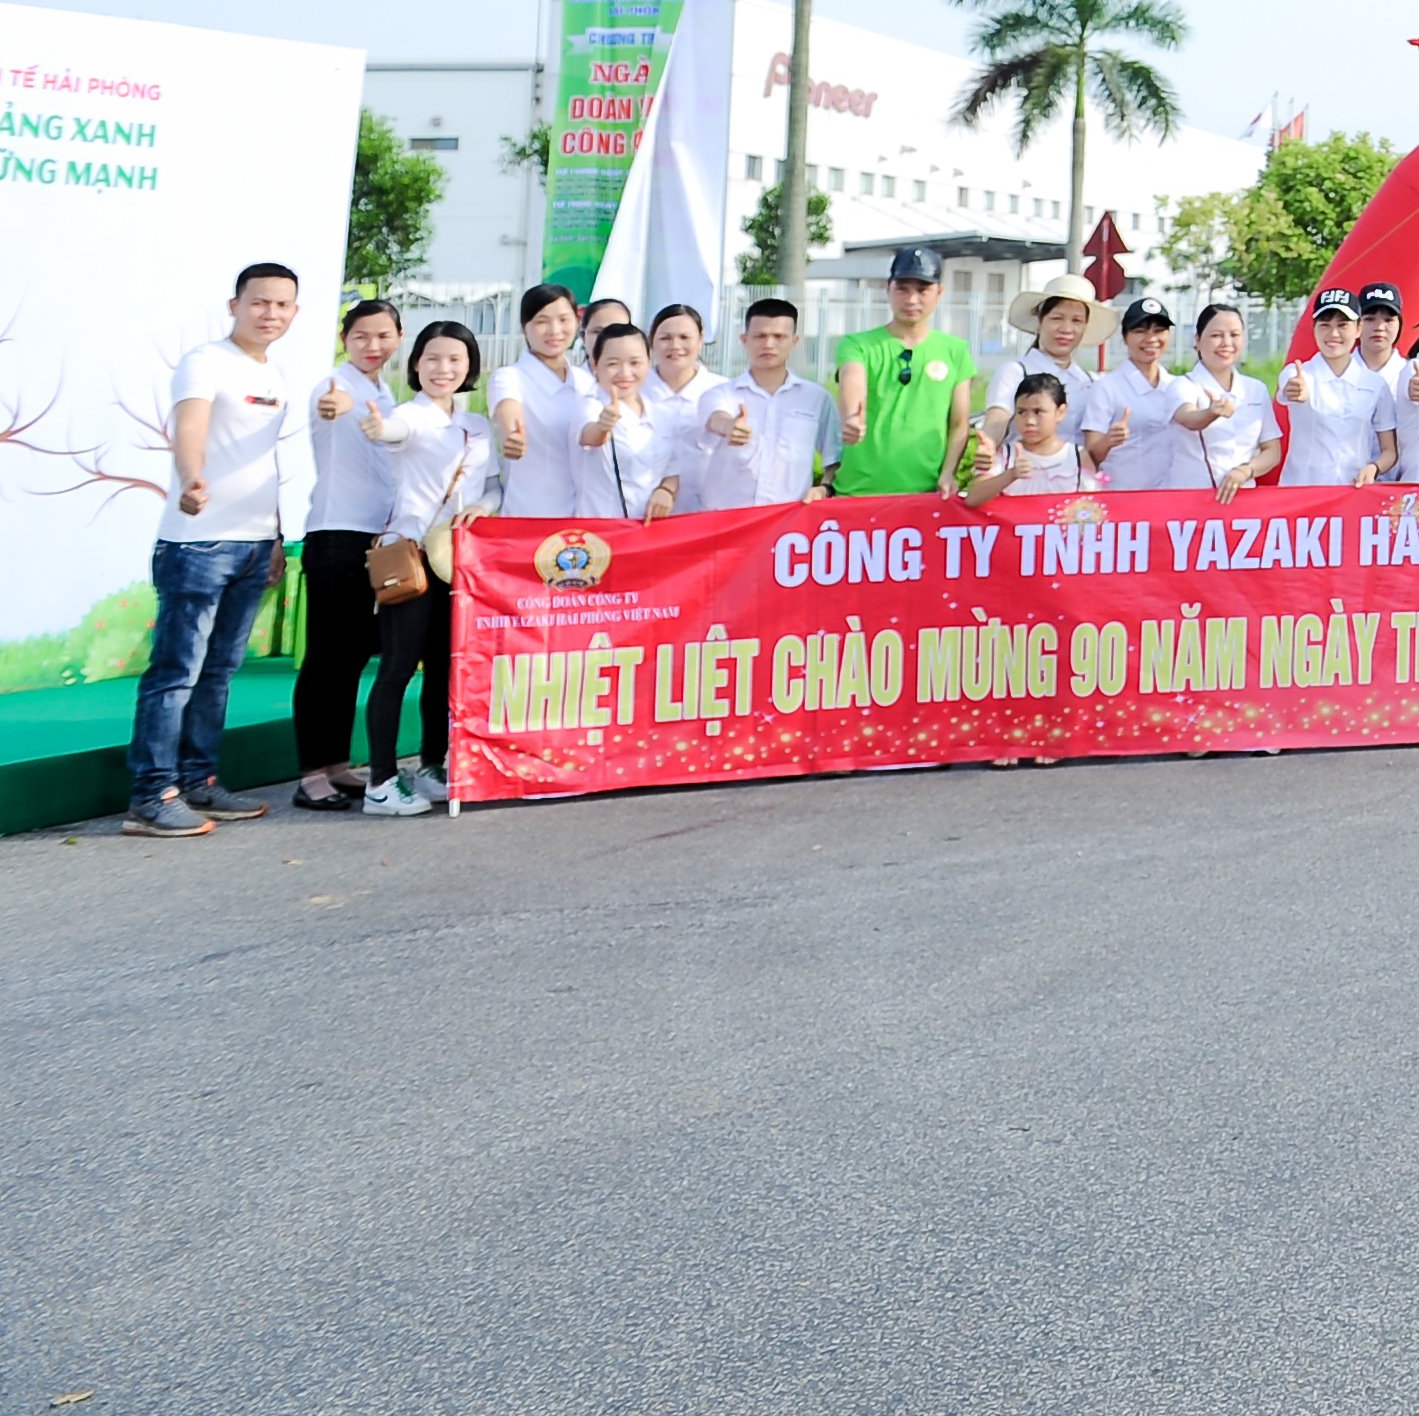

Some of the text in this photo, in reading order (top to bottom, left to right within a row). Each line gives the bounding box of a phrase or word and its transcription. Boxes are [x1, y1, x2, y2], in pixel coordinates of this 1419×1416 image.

[9, 65, 162, 102] TẾ HẢI PHÒNG
[589, 55, 650, 84] NGÀ
[763, 52, 878, 118] pneer
[0, 101, 156, 148] ẢNG XANH
[562, 127, 626, 156] CÔNG
[65, 160, 158, 194] MẠNH
[775, 520, 922, 587] CÔNG
[940, 524, 999, 579] TY
[1015, 521, 1149, 576] TNHH
[1170, 515, 1338, 572] YAZAKI
[488, 632, 645, 745] NHIỆT
[654, 623, 760, 736] LIỆT
[772, 615, 903, 713] CHÀO
[917, 606, 1058, 704] MỪNG
[1070, 621, 1127, 697] 90
[1139, 603, 1247, 694] NĂM
[1260, 598, 1380, 689] NGÀY
